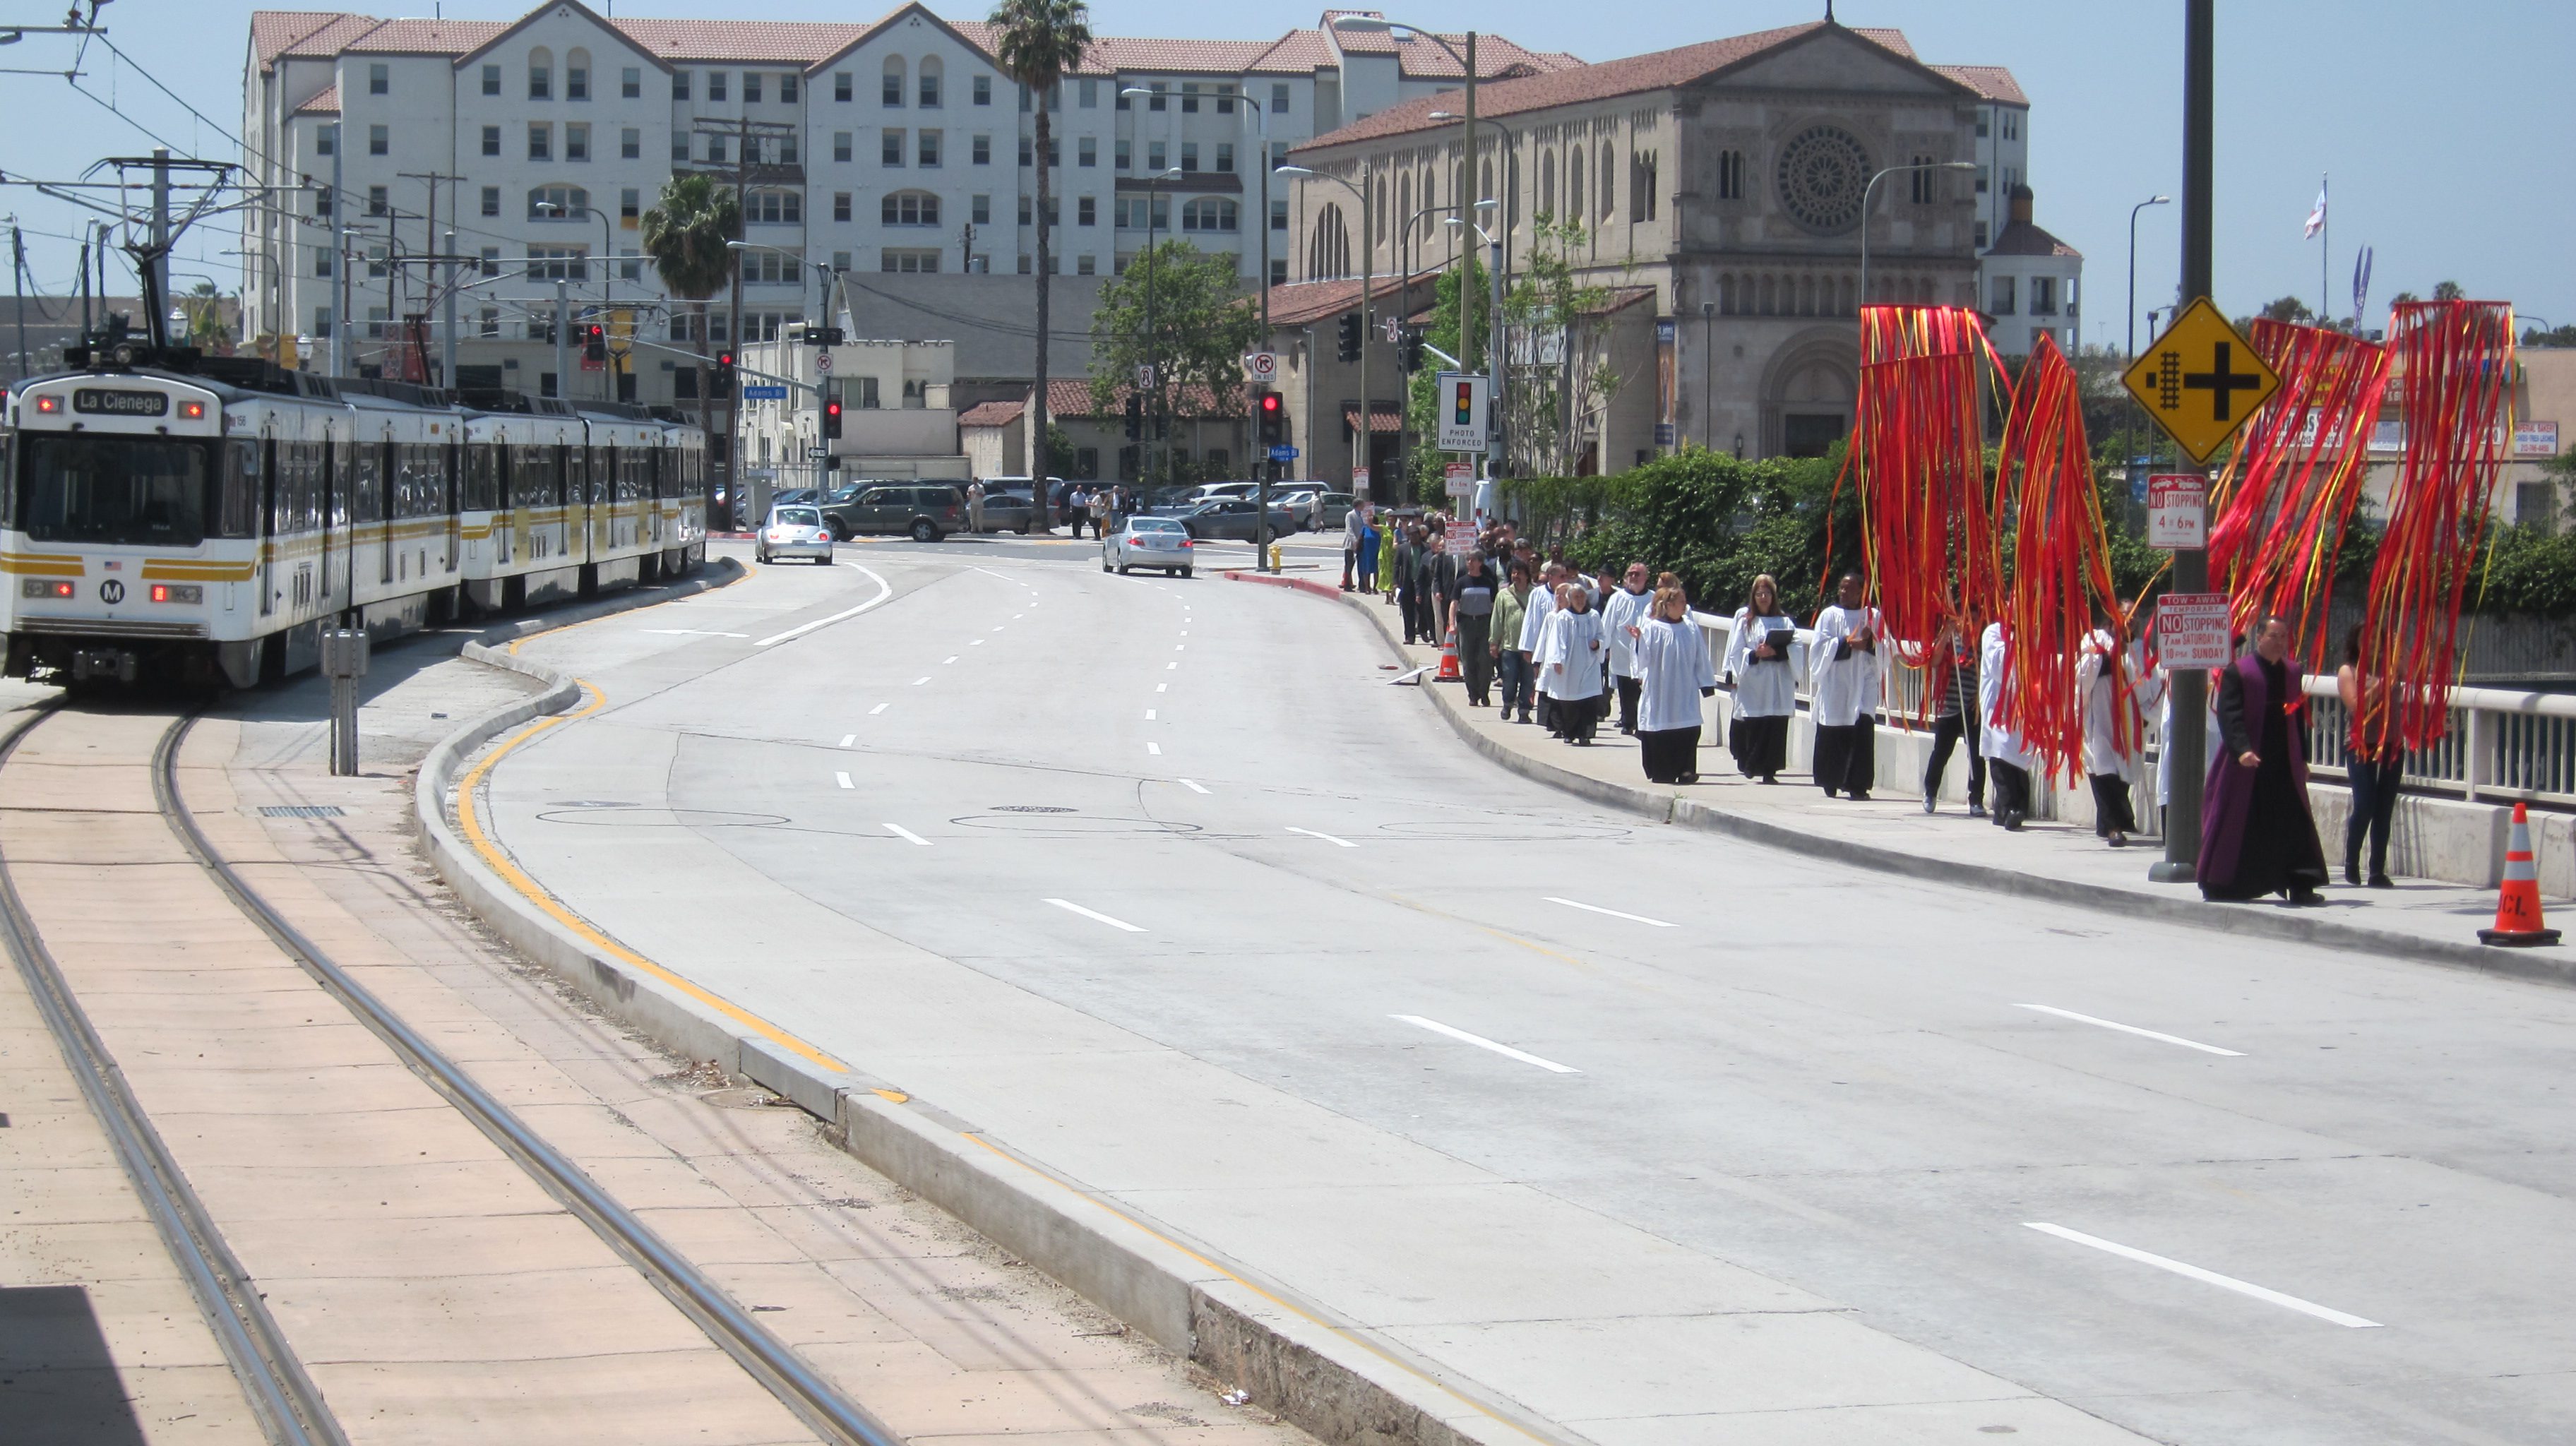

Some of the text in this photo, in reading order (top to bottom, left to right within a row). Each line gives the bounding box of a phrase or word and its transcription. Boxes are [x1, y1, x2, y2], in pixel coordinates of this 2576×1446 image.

[80, 392, 162, 413] La Cienega
[1442, 438, 1481, 446] ENFORCED
[1270, 448, 1289, 457] Adams
[2149, 491, 2203, 508] NO STOPPING
[2159, 515, 2165, 528] 4
[104, 584, 121, 600] M
[2162, 615, 2227, 633] NO STOPPING
[2183, 633, 2214, 645] SATURDAY
[2192, 648, 2224, 659] SUNDAY
